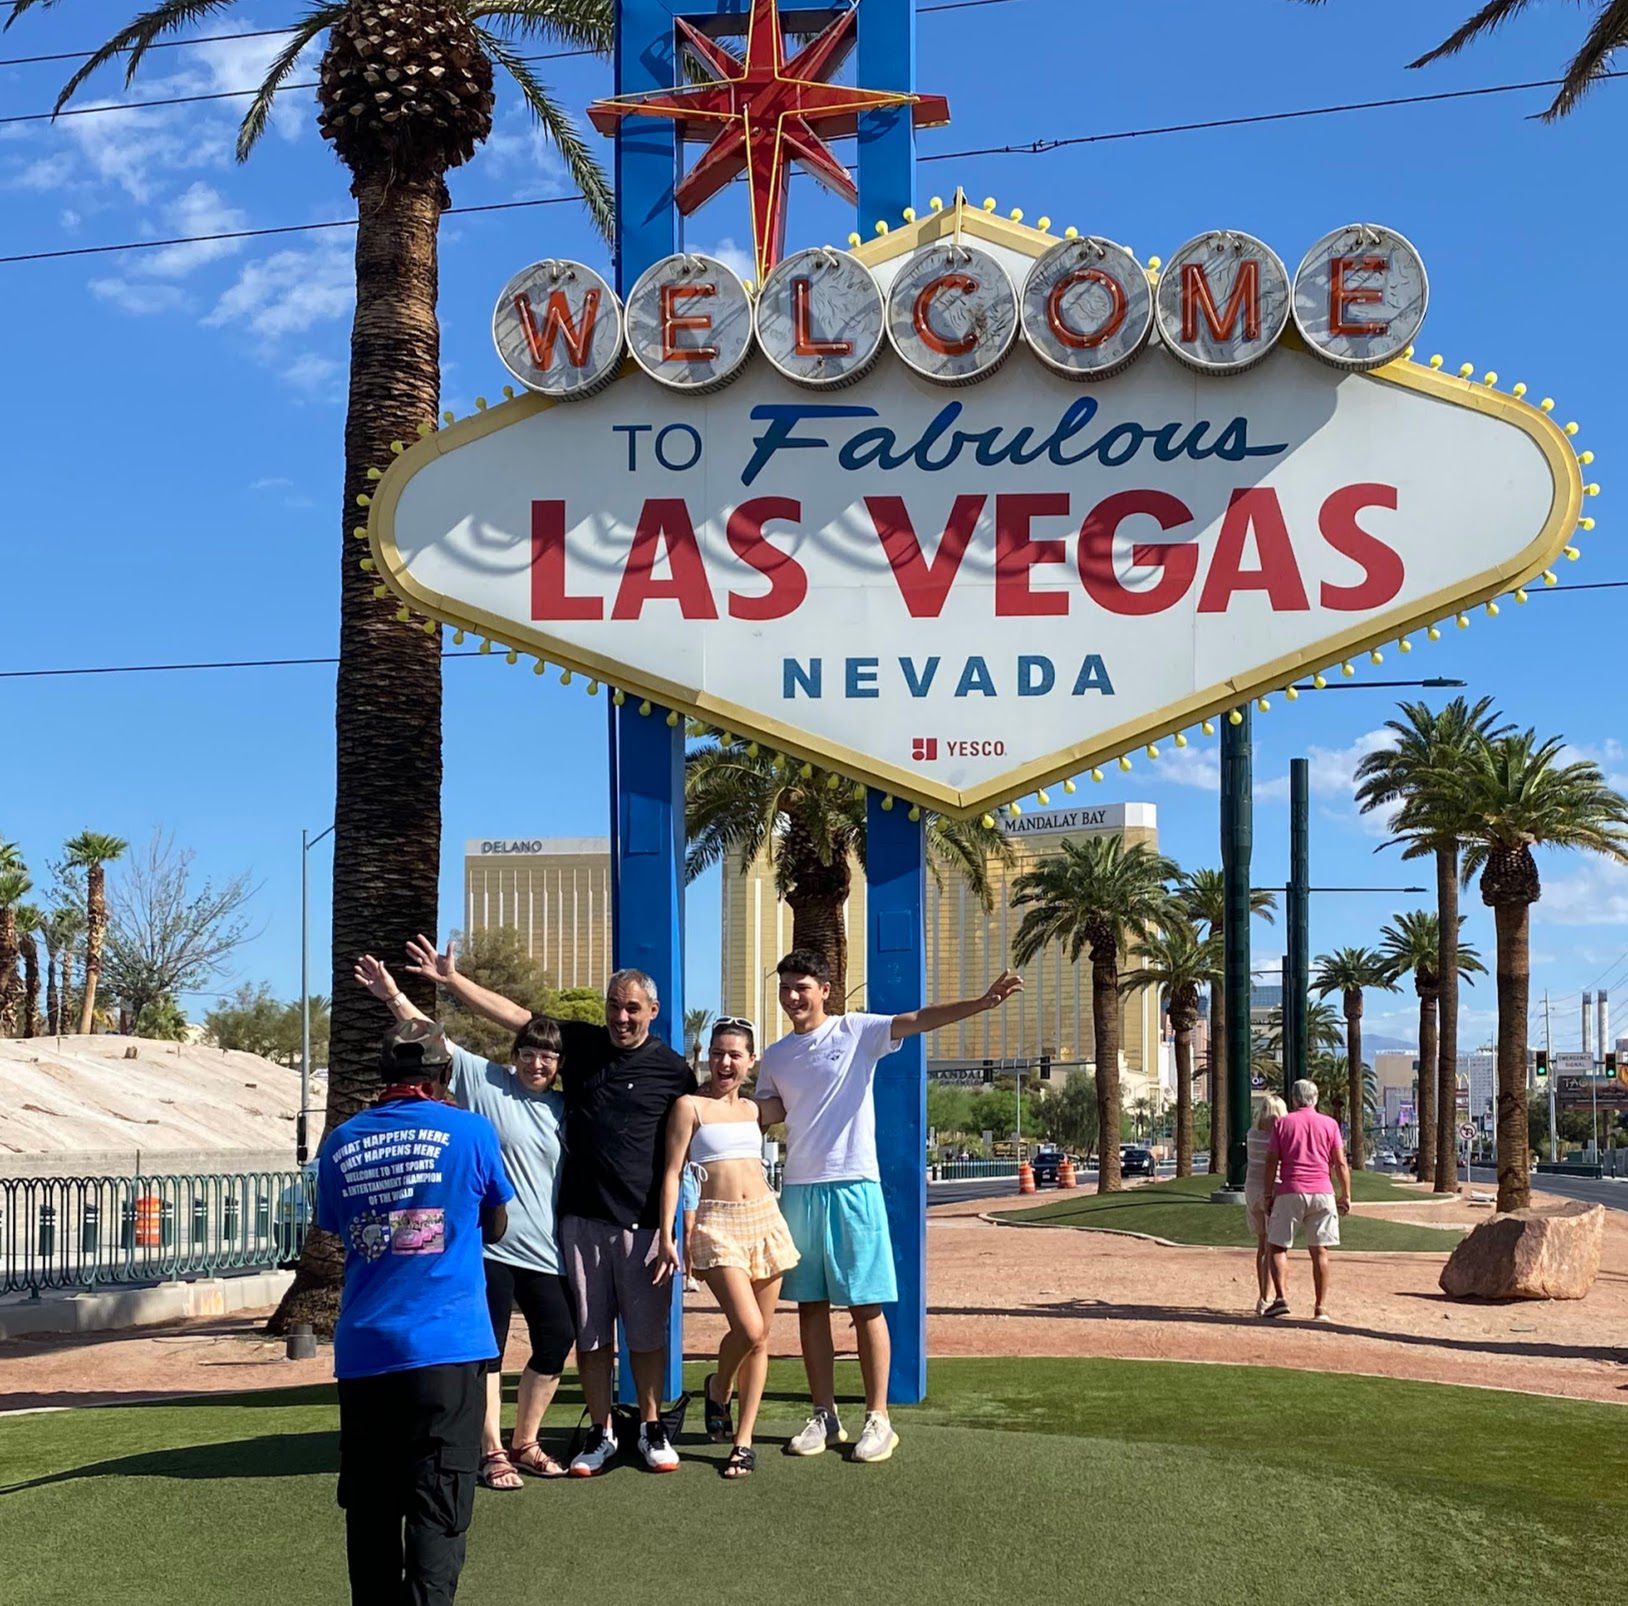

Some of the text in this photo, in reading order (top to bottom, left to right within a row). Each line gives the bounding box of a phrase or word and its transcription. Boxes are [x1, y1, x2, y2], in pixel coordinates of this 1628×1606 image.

[514, 256, 1391, 371] WELCOME
[613, 397, 1289, 485] TO Fabulous
[531, 483, 1405, 621] LAS VEGAS
[783, 654, 1115, 699] NEVADA
[946, 740, 1004, 756] YESCO
[1005, 810, 1106, 832] MANDALAY BAY
[481, 840, 543, 854] DELANO
[927, 1069, 998, 1079] MANDAL
[332, 1140, 361, 1163] WHAT
[362, 1129, 416, 1149] HAPPENS
[340, 1143, 442, 1173] ONLY HAPPENS HERE
[344, 1159, 435, 1183] WELCOME TO THE SPORTS
[368, 1187, 414, 1206] OF THE WRLD
